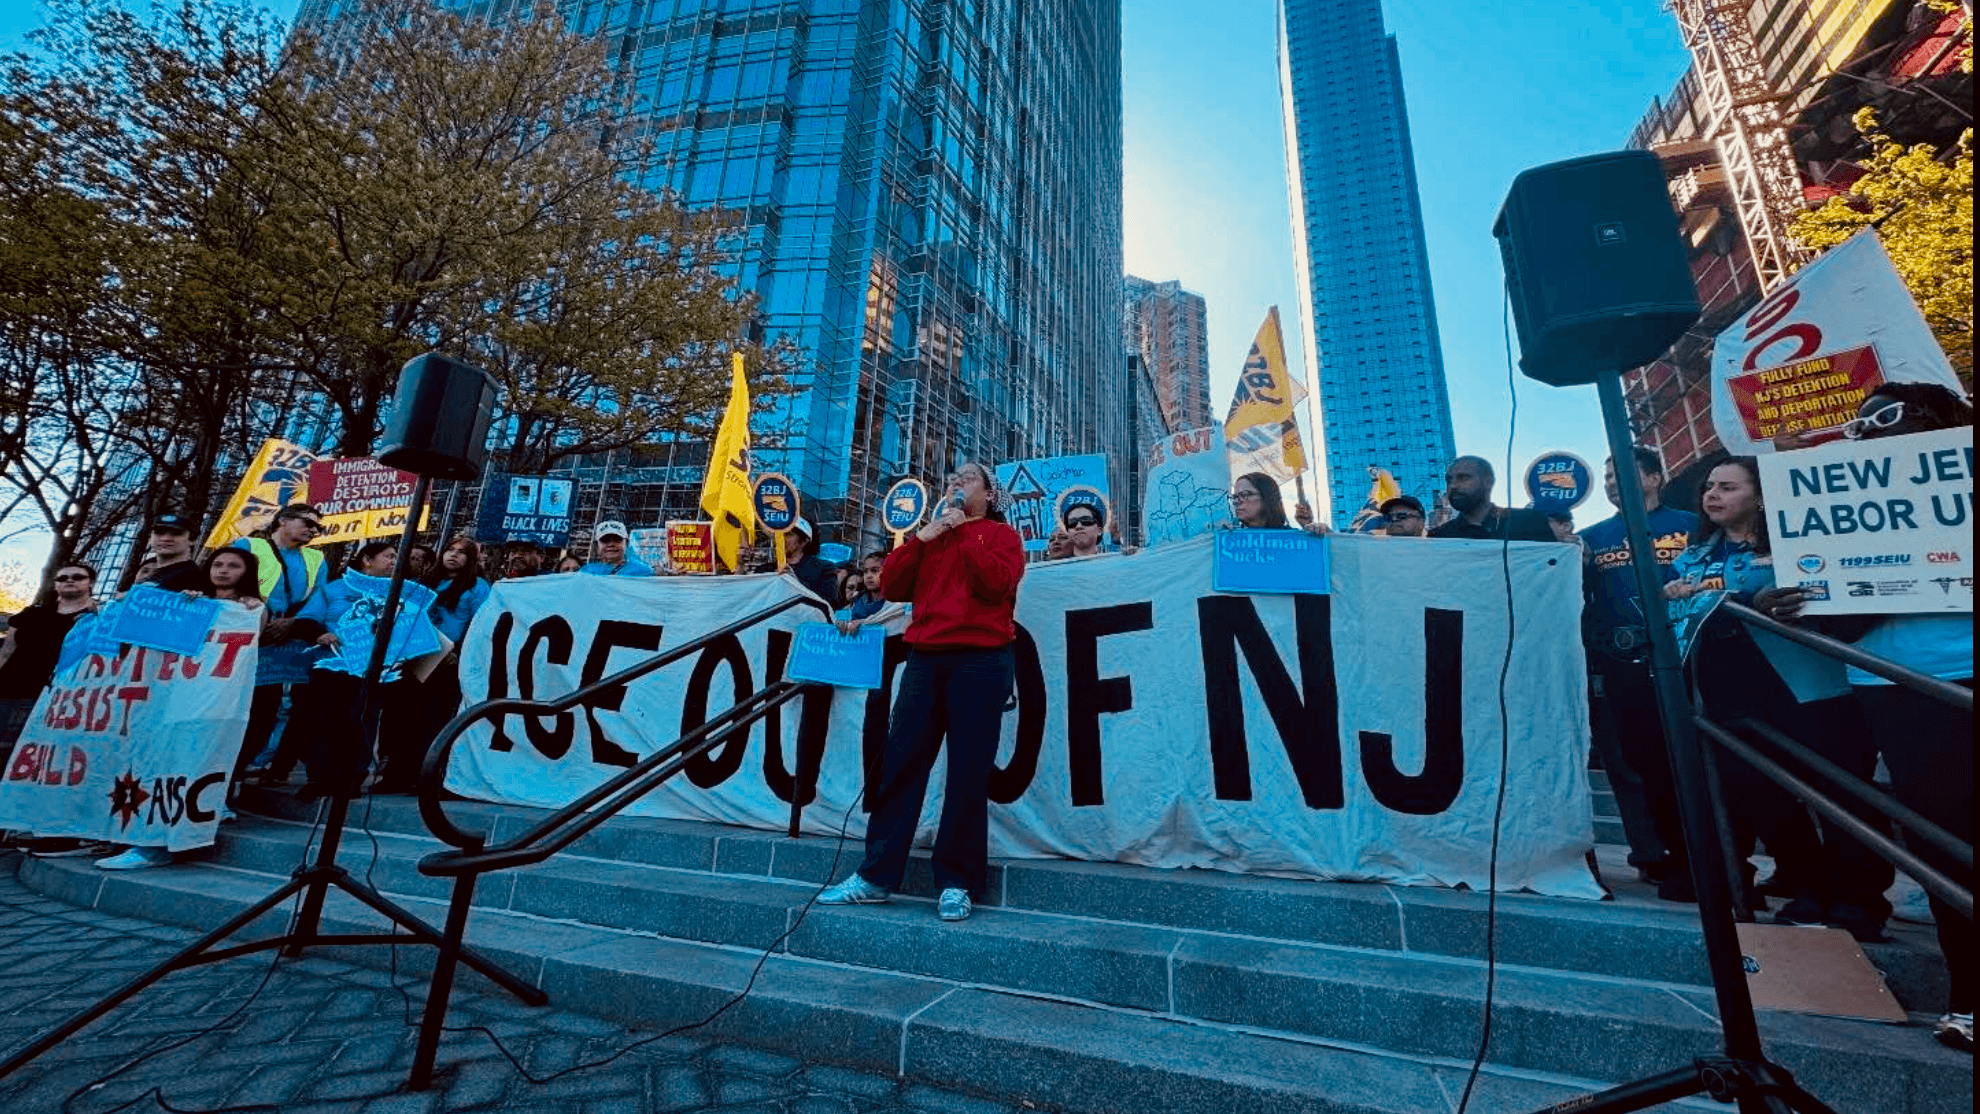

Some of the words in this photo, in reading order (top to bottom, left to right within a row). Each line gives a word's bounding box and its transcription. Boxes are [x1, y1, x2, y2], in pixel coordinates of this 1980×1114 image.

[1760, 367, 1793, 384] FULLY
[1797, 358, 1831, 376] FUND
[1755, 387, 1781, 403] NJ'S
[1783, 372, 1851, 398] DETENTION
[1758, 406, 1779, 420] AND
[1781, 388, 1865, 416] DEPORTATION
[1760, 418, 1804, 437] DEFSE
[1808, 408, 1858, 428] INITIATI
[333, 459, 391, 474] IMMIGRA
[1537, 459, 1576, 474] 32BJ
[336, 471, 397, 488] DETENTION
[1789, 457, 1891, 497] NEW
[333, 482, 410, 500] DESTROYS
[760, 485, 787, 495] 32BJ
[894, 488, 919, 498] 32BJ
[314, 500, 344, 515] OUR
[346, 493, 414, 513] COMMUNI
[1068, 496, 1098, 506] 32BJ
[763, 509, 790, 522] SEIU
[889, 510, 915, 523] SEIU
[1778, 499, 1918, 538] LABOR
[1931, 492, 1973, 527] U
[321, 523, 341, 536] ND
[344, 519, 363, 533] IT
[502, 515, 538, 531] BLACK
[542, 518, 570, 533] LIVES
[1221, 534, 1309, 551] Goldman
[1221, 549, 1275, 564] Sucks
[1594, 551, 1630, 565] GOO
[1839, 554, 1911, 566] 1199SEIU
[1926, 552, 1961, 563] CWA
[131, 589, 208, 615] Goldman
[128, 602, 182, 622] Sucks
[803, 626, 870, 645] Goldman
[800, 640, 845, 656] Sucks
[45, 685, 149, 736] RESIST
[487, 611, 664, 769] ICE
[680, 627, 908, 813] OUT
[1197, 593, 1465, 815] NJ
